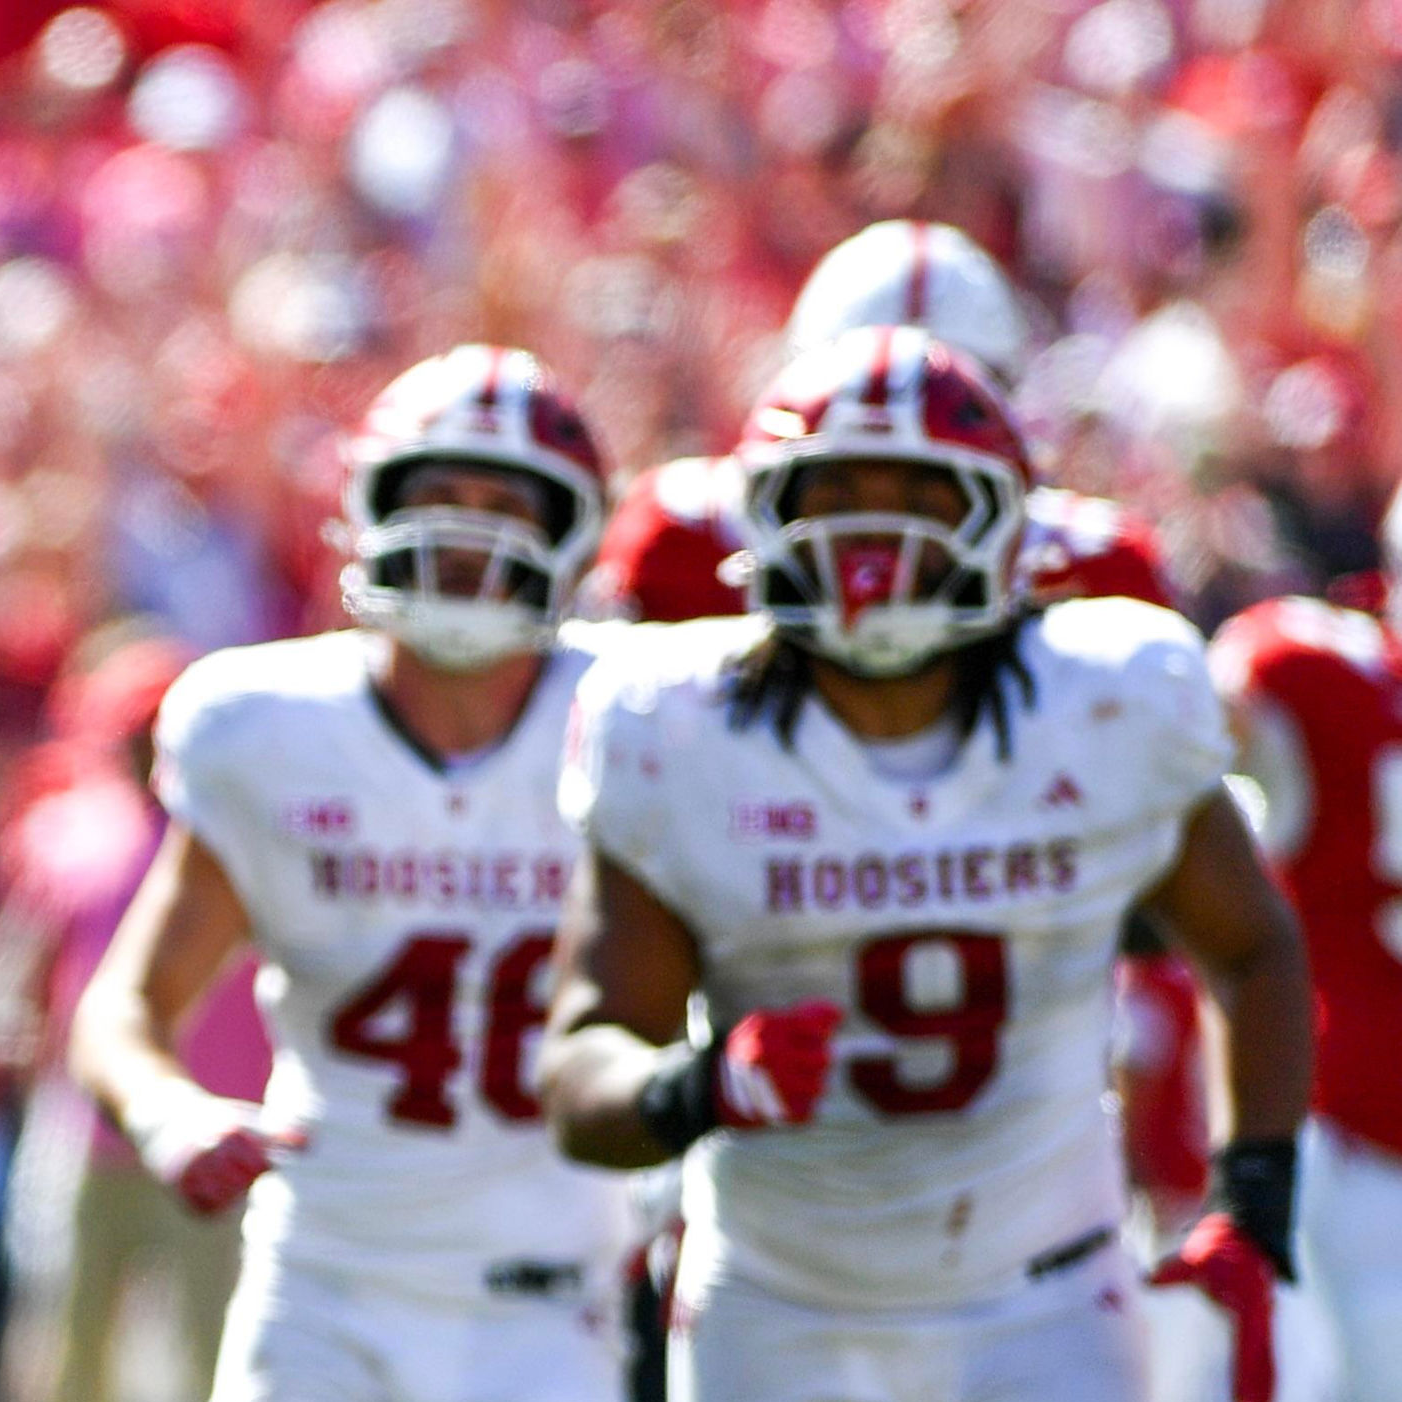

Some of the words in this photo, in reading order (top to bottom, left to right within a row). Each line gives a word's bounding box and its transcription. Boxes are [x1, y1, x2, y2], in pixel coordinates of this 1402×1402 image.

[311, 852, 568, 903] HOOSIER
[766, 839, 1077, 912] HOOSIERS
[848, 931, 1007, 1119] 9
